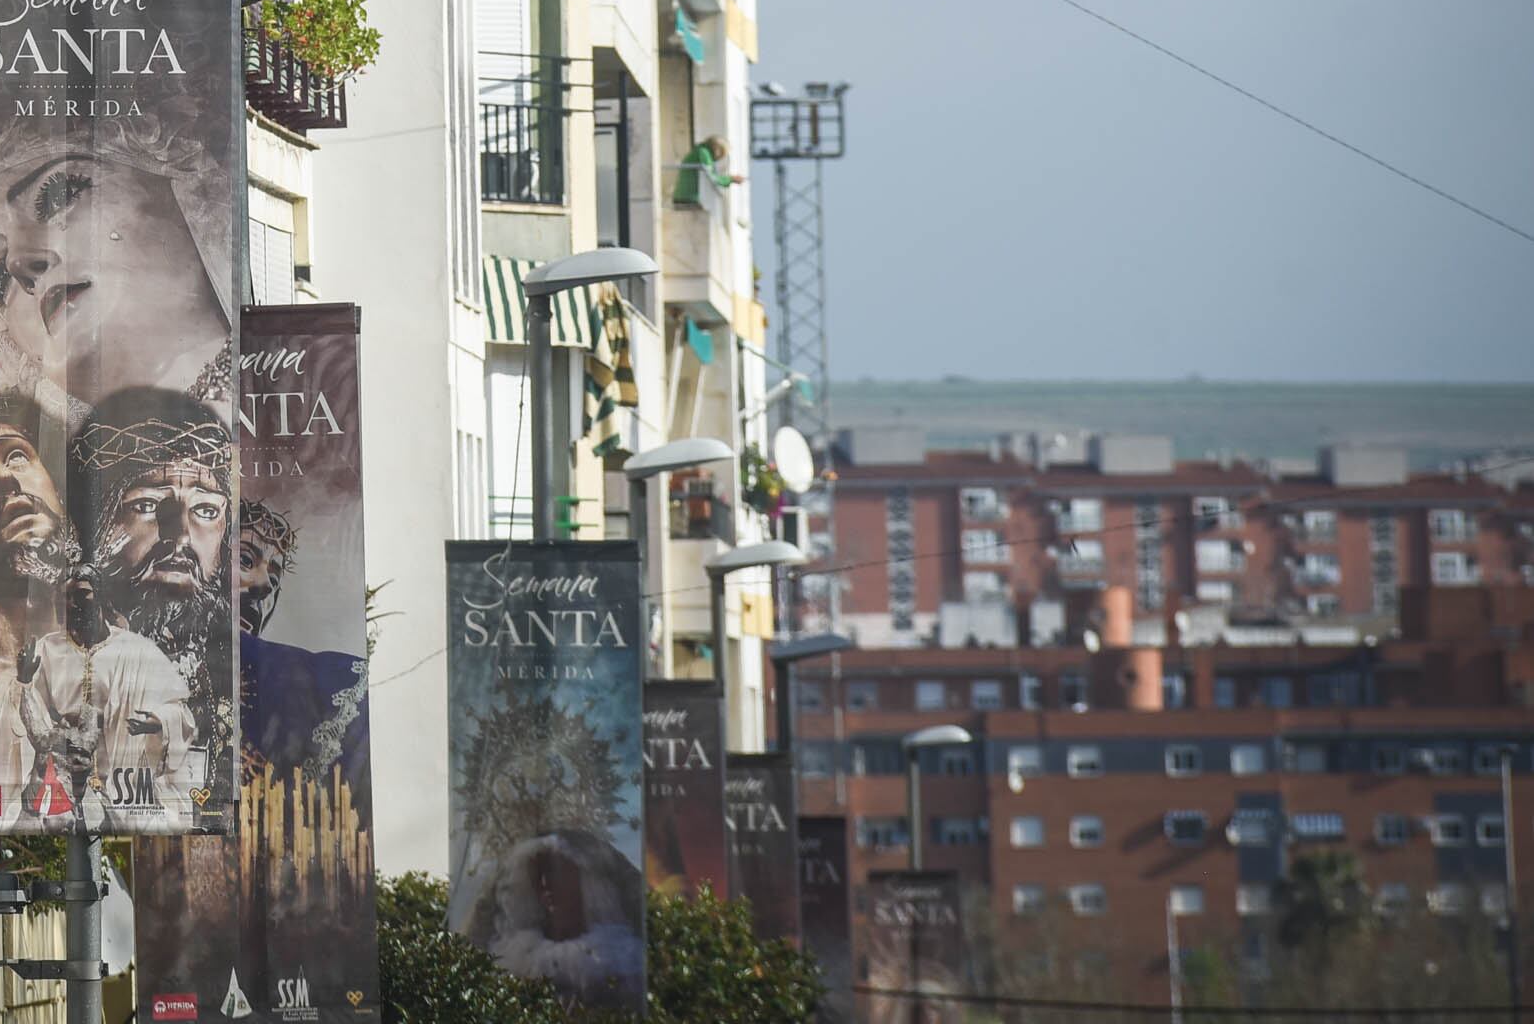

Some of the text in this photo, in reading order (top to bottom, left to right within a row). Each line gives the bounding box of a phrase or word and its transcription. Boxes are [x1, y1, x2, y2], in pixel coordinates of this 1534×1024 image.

[14, 93, 144, 117] MÉRIDA
[239, 391, 345, 438] NTA
[241, 460, 304, 477] IDA
[462, 547, 599, 609] Semana
[464, 610, 628, 648] SANTA
[642, 738, 713, 769] NTA
[112, 767, 155, 805] SSM
[278, 977, 310, 1008] SSM
